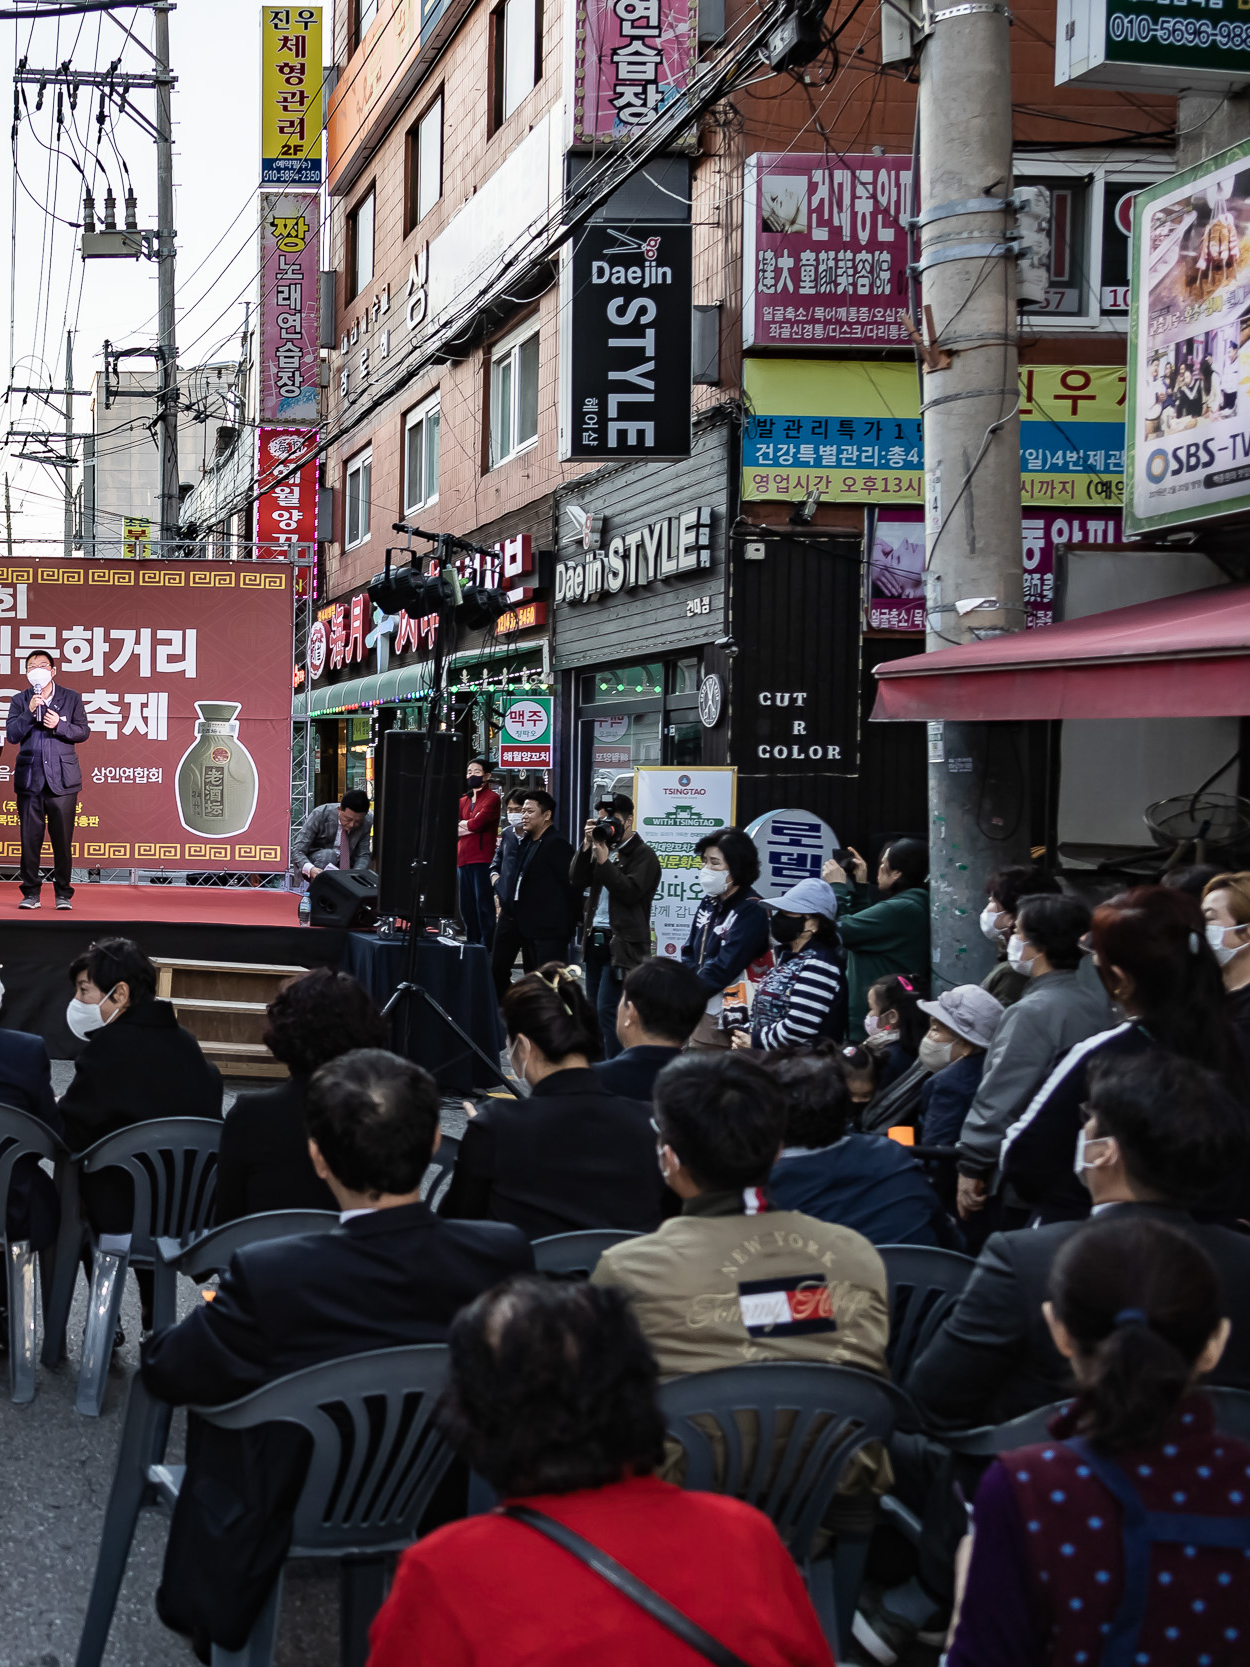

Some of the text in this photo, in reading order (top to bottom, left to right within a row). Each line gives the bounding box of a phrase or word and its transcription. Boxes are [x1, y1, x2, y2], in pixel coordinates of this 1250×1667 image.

[269, 9, 318, 31] 진우
[275, 34, 309, 141] 체형관리
[281, 145, 304, 156] 2F
[272, 216, 309, 252] 짱
[592, 261, 672, 288] Daejin
[276, 255, 303, 398] 노래연습장
[607, 297, 657, 448] STYLE
[582, 397, 599, 447] 헤어샵
[753, 474, 831, 495] 영업시간
[840, 476, 922, 497] 오후13시
[607, 510, 699, 593] STYLE
[555, 552, 603, 603] Daejin
[686, 596, 710, 617] 건대점
[758, 692, 807, 707] CUT
[509, 710, 543, 728] 맥주
[791, 720, 807, 735] R
[502, 751, 549, 763] 해월양꼬치
[758, 745, 842, 760] COLOR
[91, 767, 163, 784] 상인연합회
[663, 788, 707, 796] TSINGTAO
[675, 819, 715, 827] TSINGTAO
